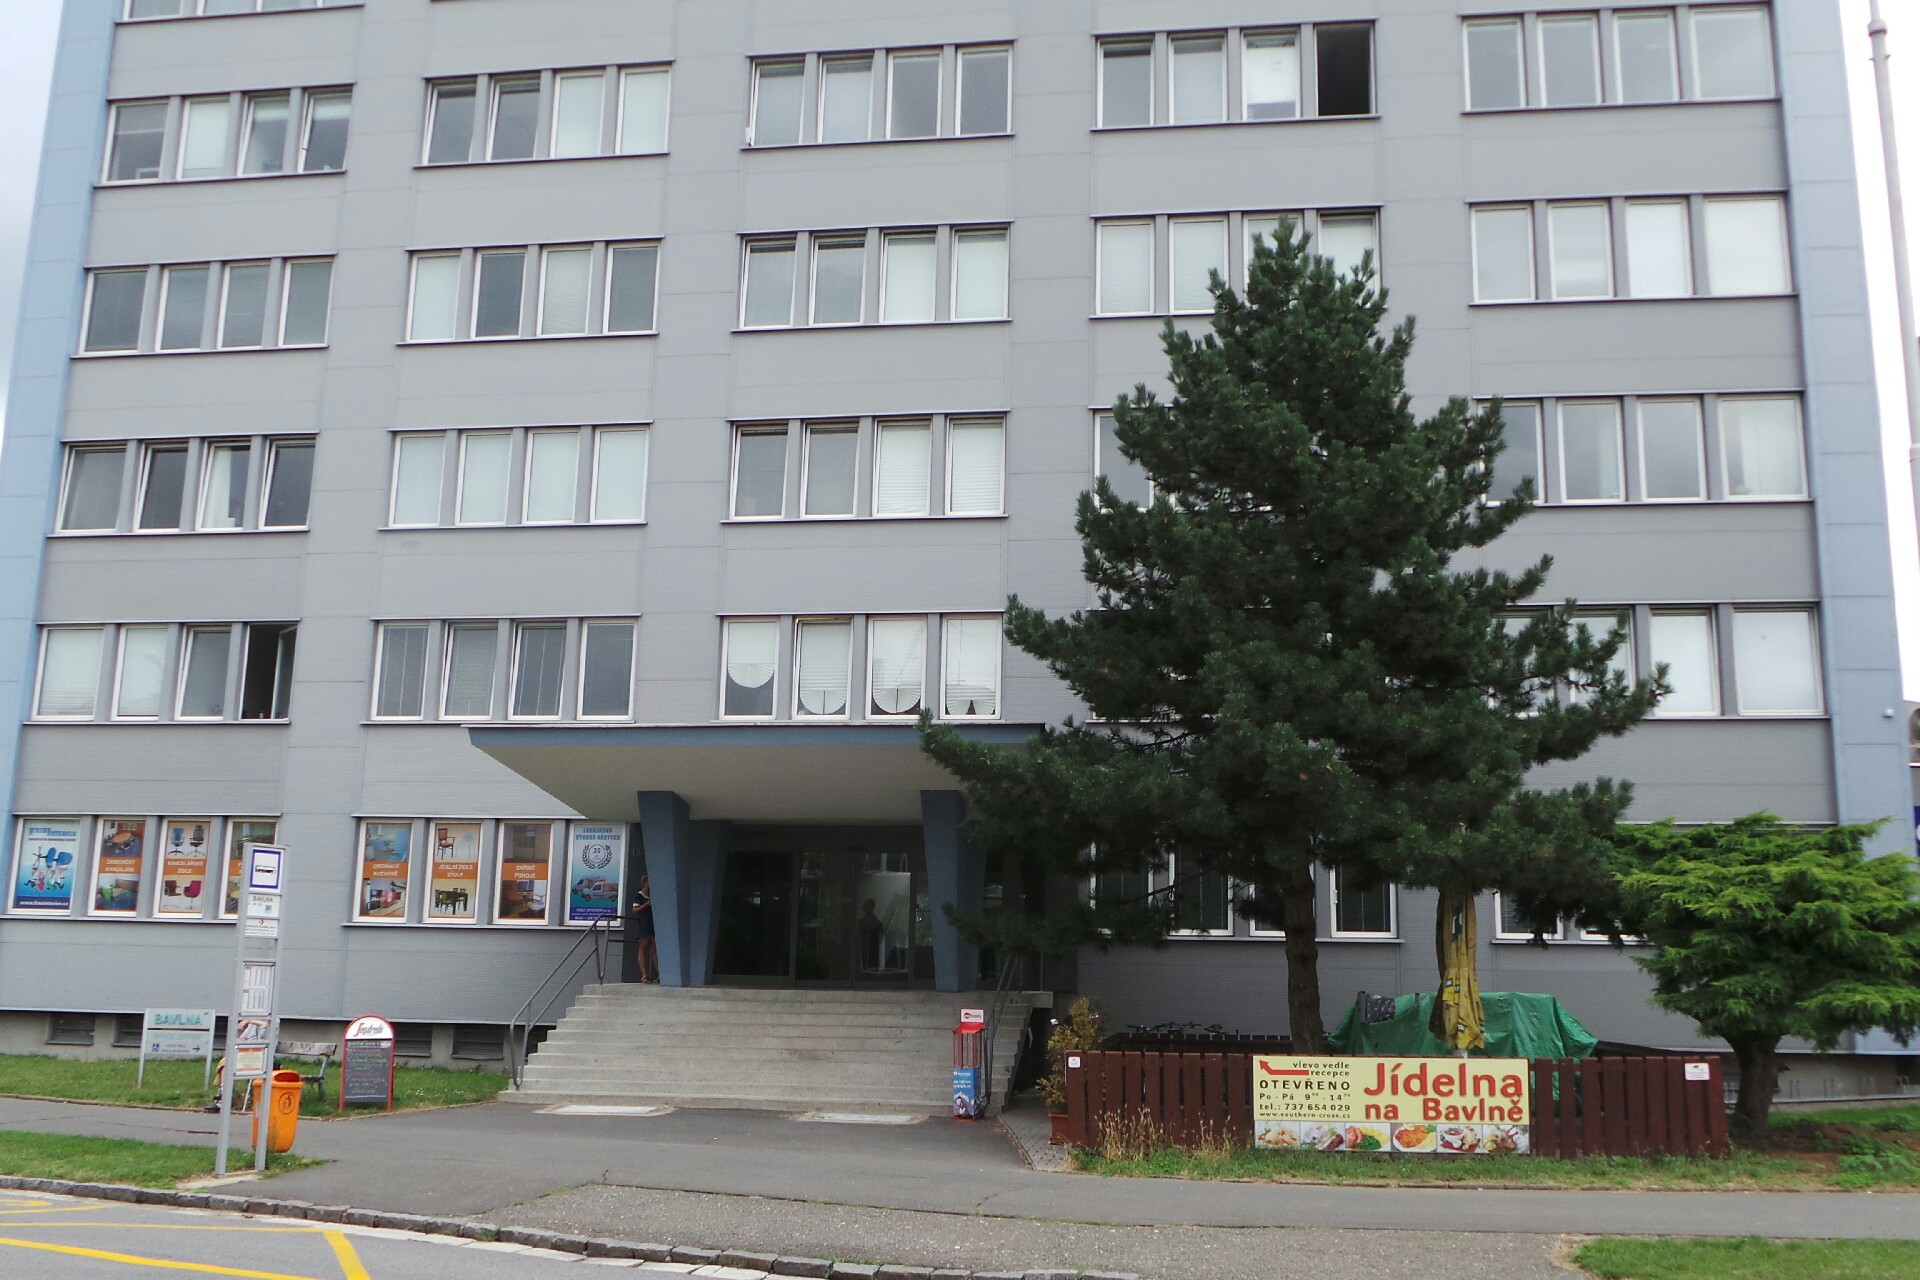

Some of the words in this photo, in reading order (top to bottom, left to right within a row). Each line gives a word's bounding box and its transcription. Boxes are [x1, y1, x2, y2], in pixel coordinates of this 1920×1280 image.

[252, 895, 274, 903] BAVLNA
[154, 1013, 203, 1026] BAVLNA
[1293, 1061, 1320, 1069] vlevo
[1322, 1061, 1350, 1069] vedle
[1310, 1070, 1350, 1078] recepce
[1259, 1078, 1350, 1091] OTEVŘENO
[1364, 1062, 1524, 1098] Jídelna
[1259, 1092, 1271, 1100] Po
[1282, 1093, 1294, 1101] Pá
[1259, 1103, 1281, 1111] tel.:
[1284, 1103, 1304, 1111] 737
[1307, 1103, 1327, 1111] 654
[1330, 1104, 1350, 1112] 029
[1365, 1103, 1399, 1121] na
[1422, 1098, 1524, 1122] Bavlně
[1259, 1111, 1351, 1119] www.southern-cross.cz
